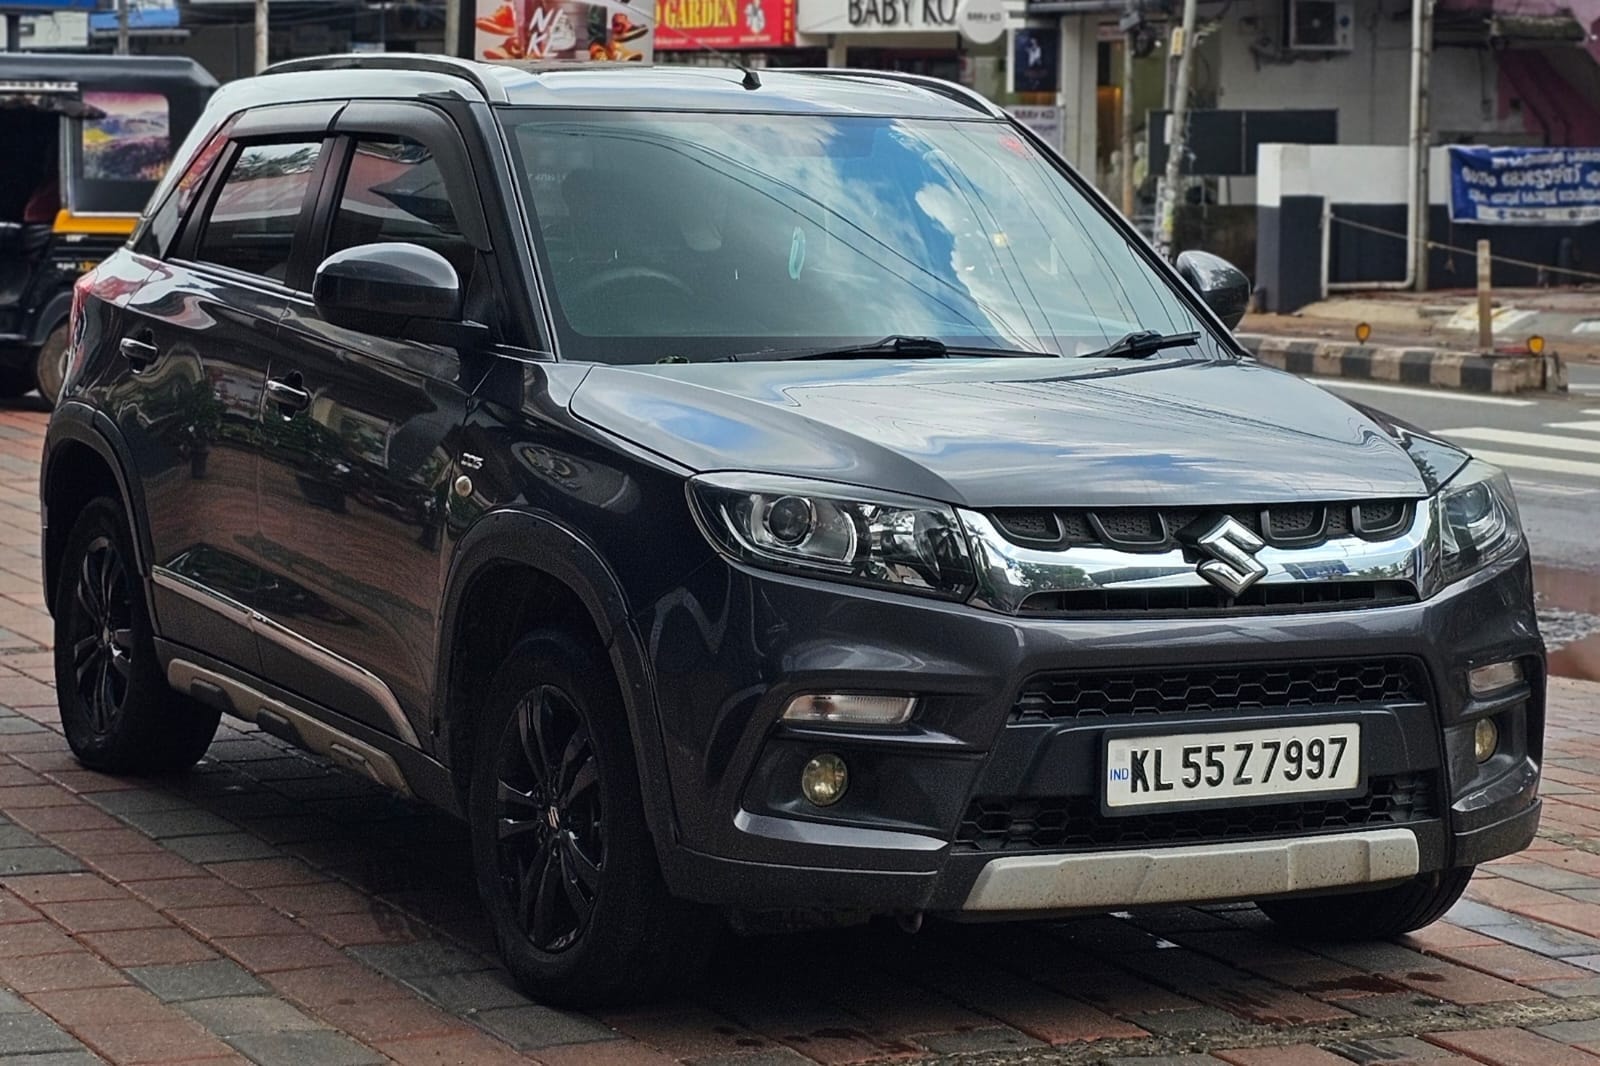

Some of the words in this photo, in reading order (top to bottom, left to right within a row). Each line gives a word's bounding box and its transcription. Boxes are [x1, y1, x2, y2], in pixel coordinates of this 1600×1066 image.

[664, 0, 737, 28] GARDEN
[848, 0, 912, 25] BABY
[1109, 767, 1129, 782] IND
[1130, 748, 1174, 793] KL
[1181, 744, 1226, 789] 55
[1232, 742, 1254, 786] Z
[1260, 736, 1348, 784] 7997
